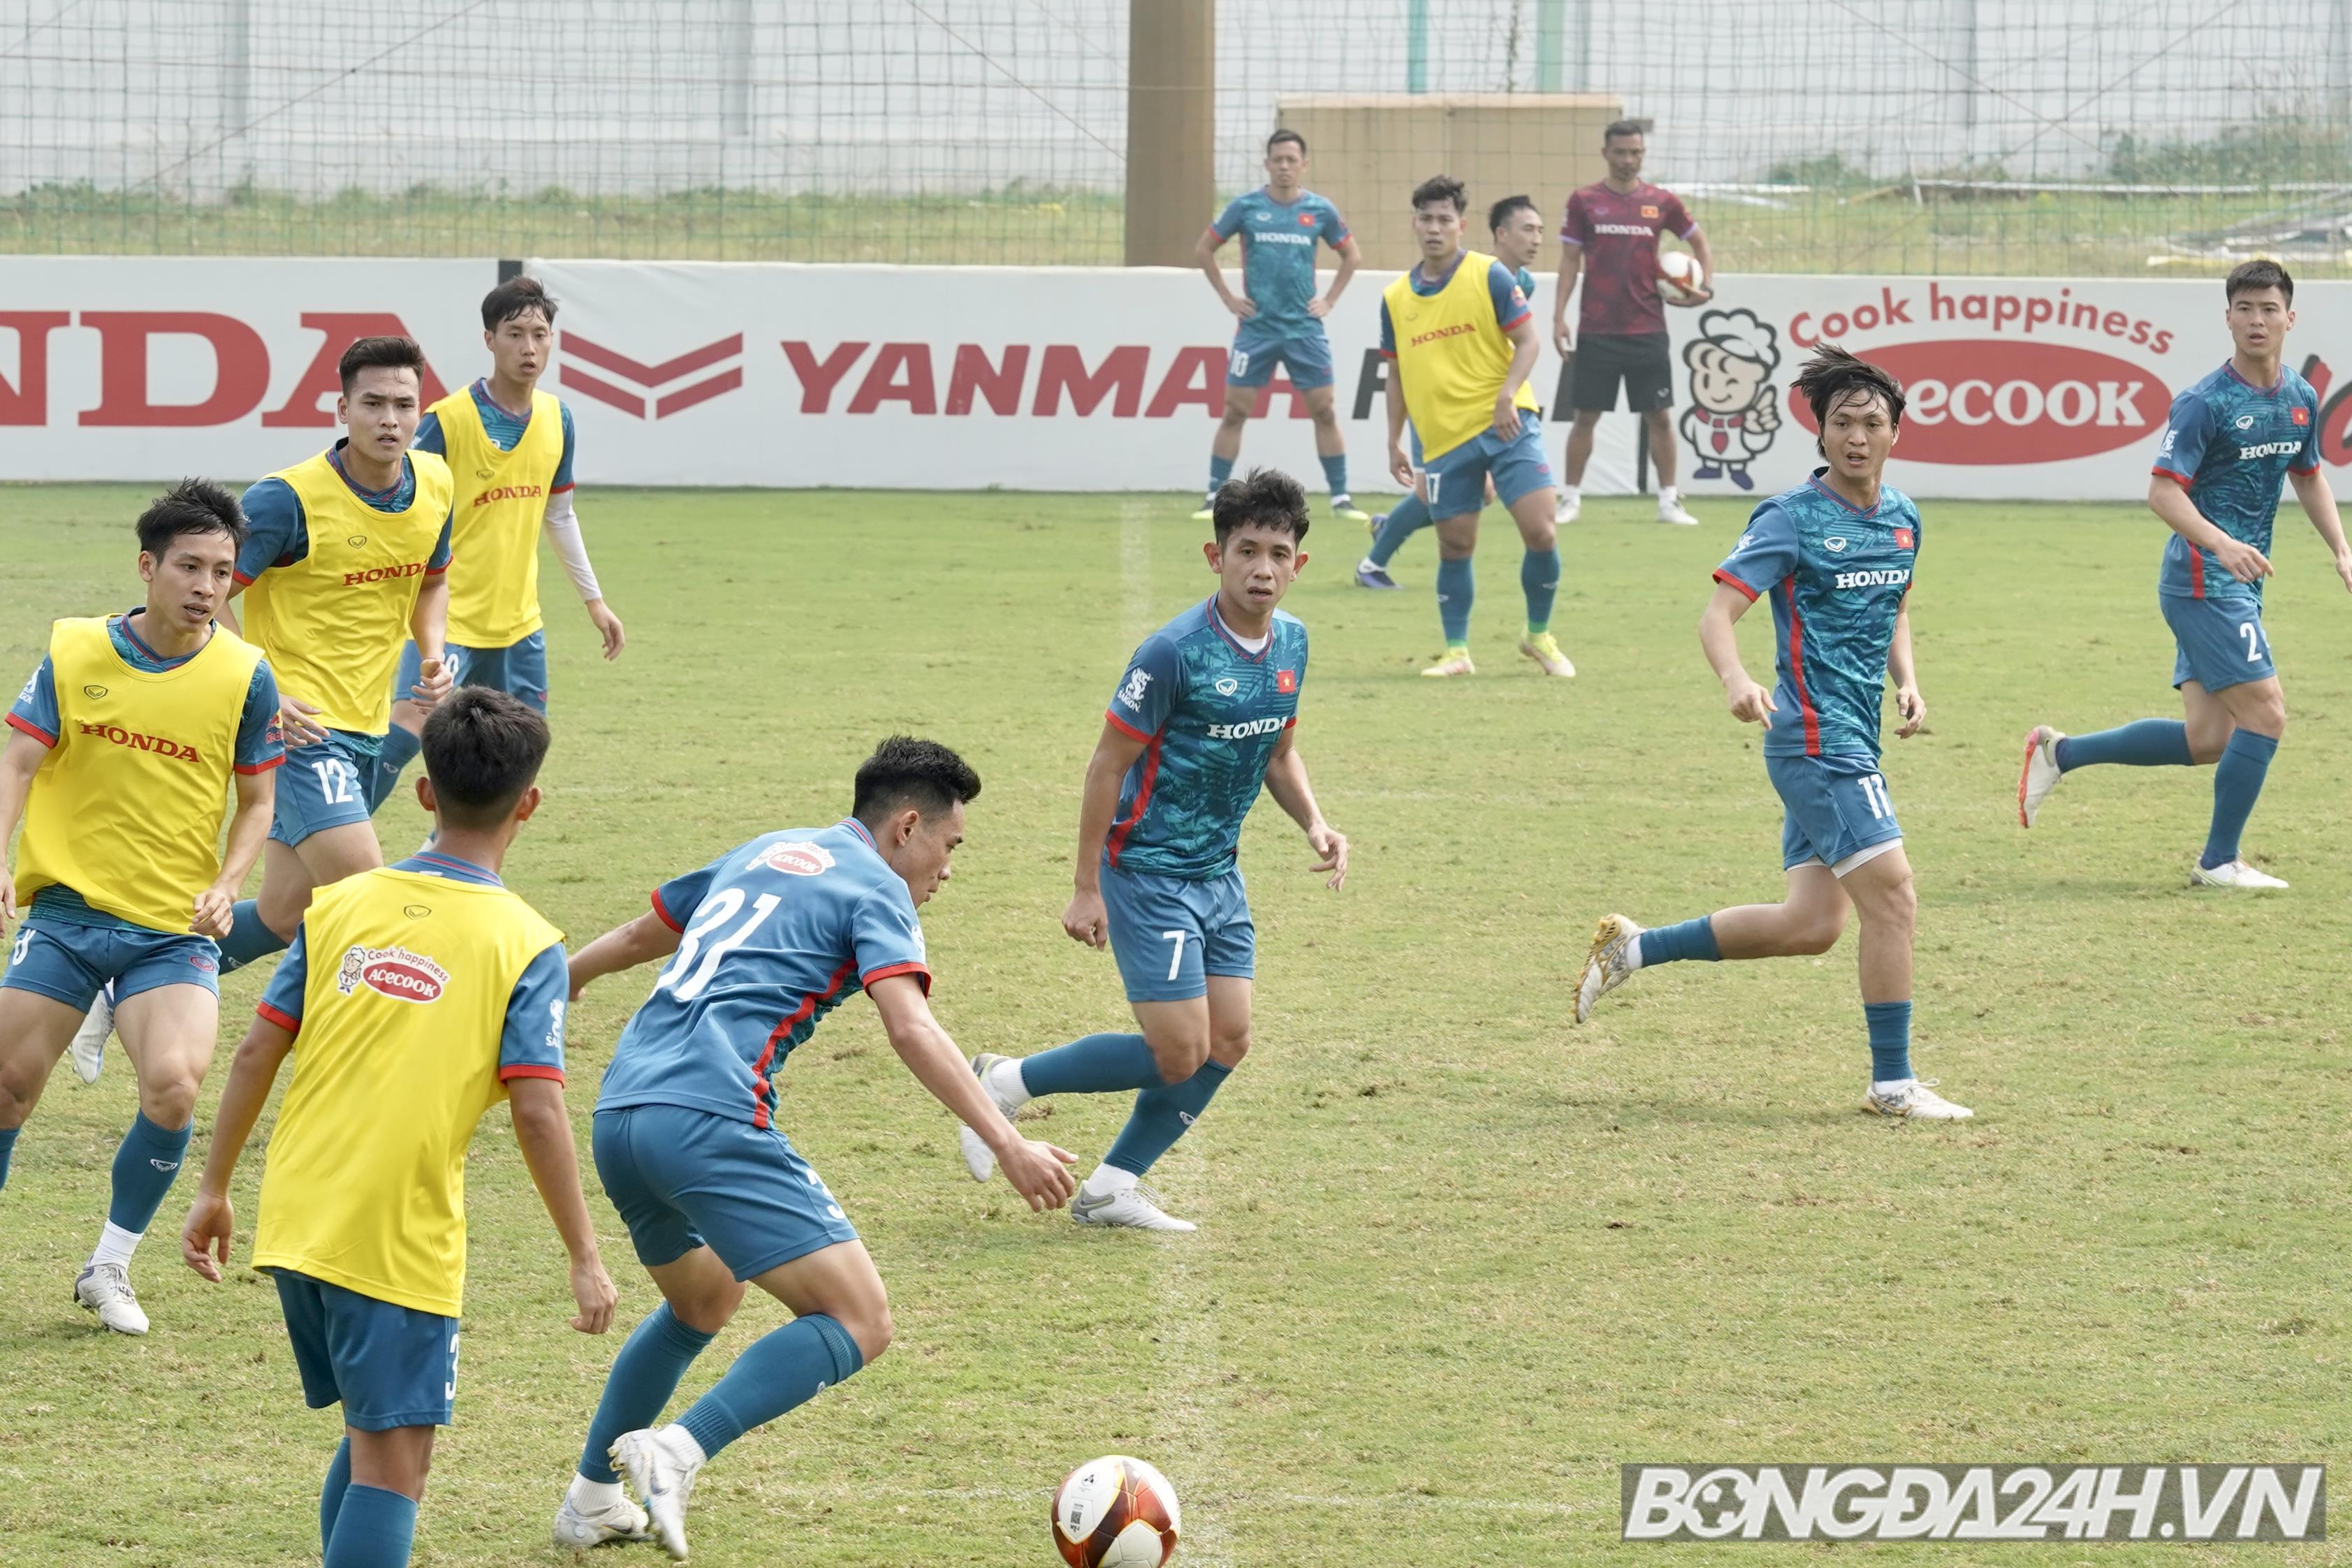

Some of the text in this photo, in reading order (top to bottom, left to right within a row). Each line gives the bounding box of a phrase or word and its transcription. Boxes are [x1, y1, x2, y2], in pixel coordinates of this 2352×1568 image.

[1254, 232, 1312, 246] HONDA
[1595, 224, 1655, 237] HONDA
[1411, 323, 1476, 346] HONDA
[1789, 282, 2175, 355] Cook happiness
[2239, 441, 2302, 460] HONDA
[473, 485, 541, 507] HONDA
[80, 724, 200, 763] HONDA
[311, 758, 353, 805] 12
[1857, 774, 1892, 819] 11
[648, 888, 782, 1002] 31
[1162, 930, 1185, 981] 7
[367, 948, 449, 982] Cook happiness
